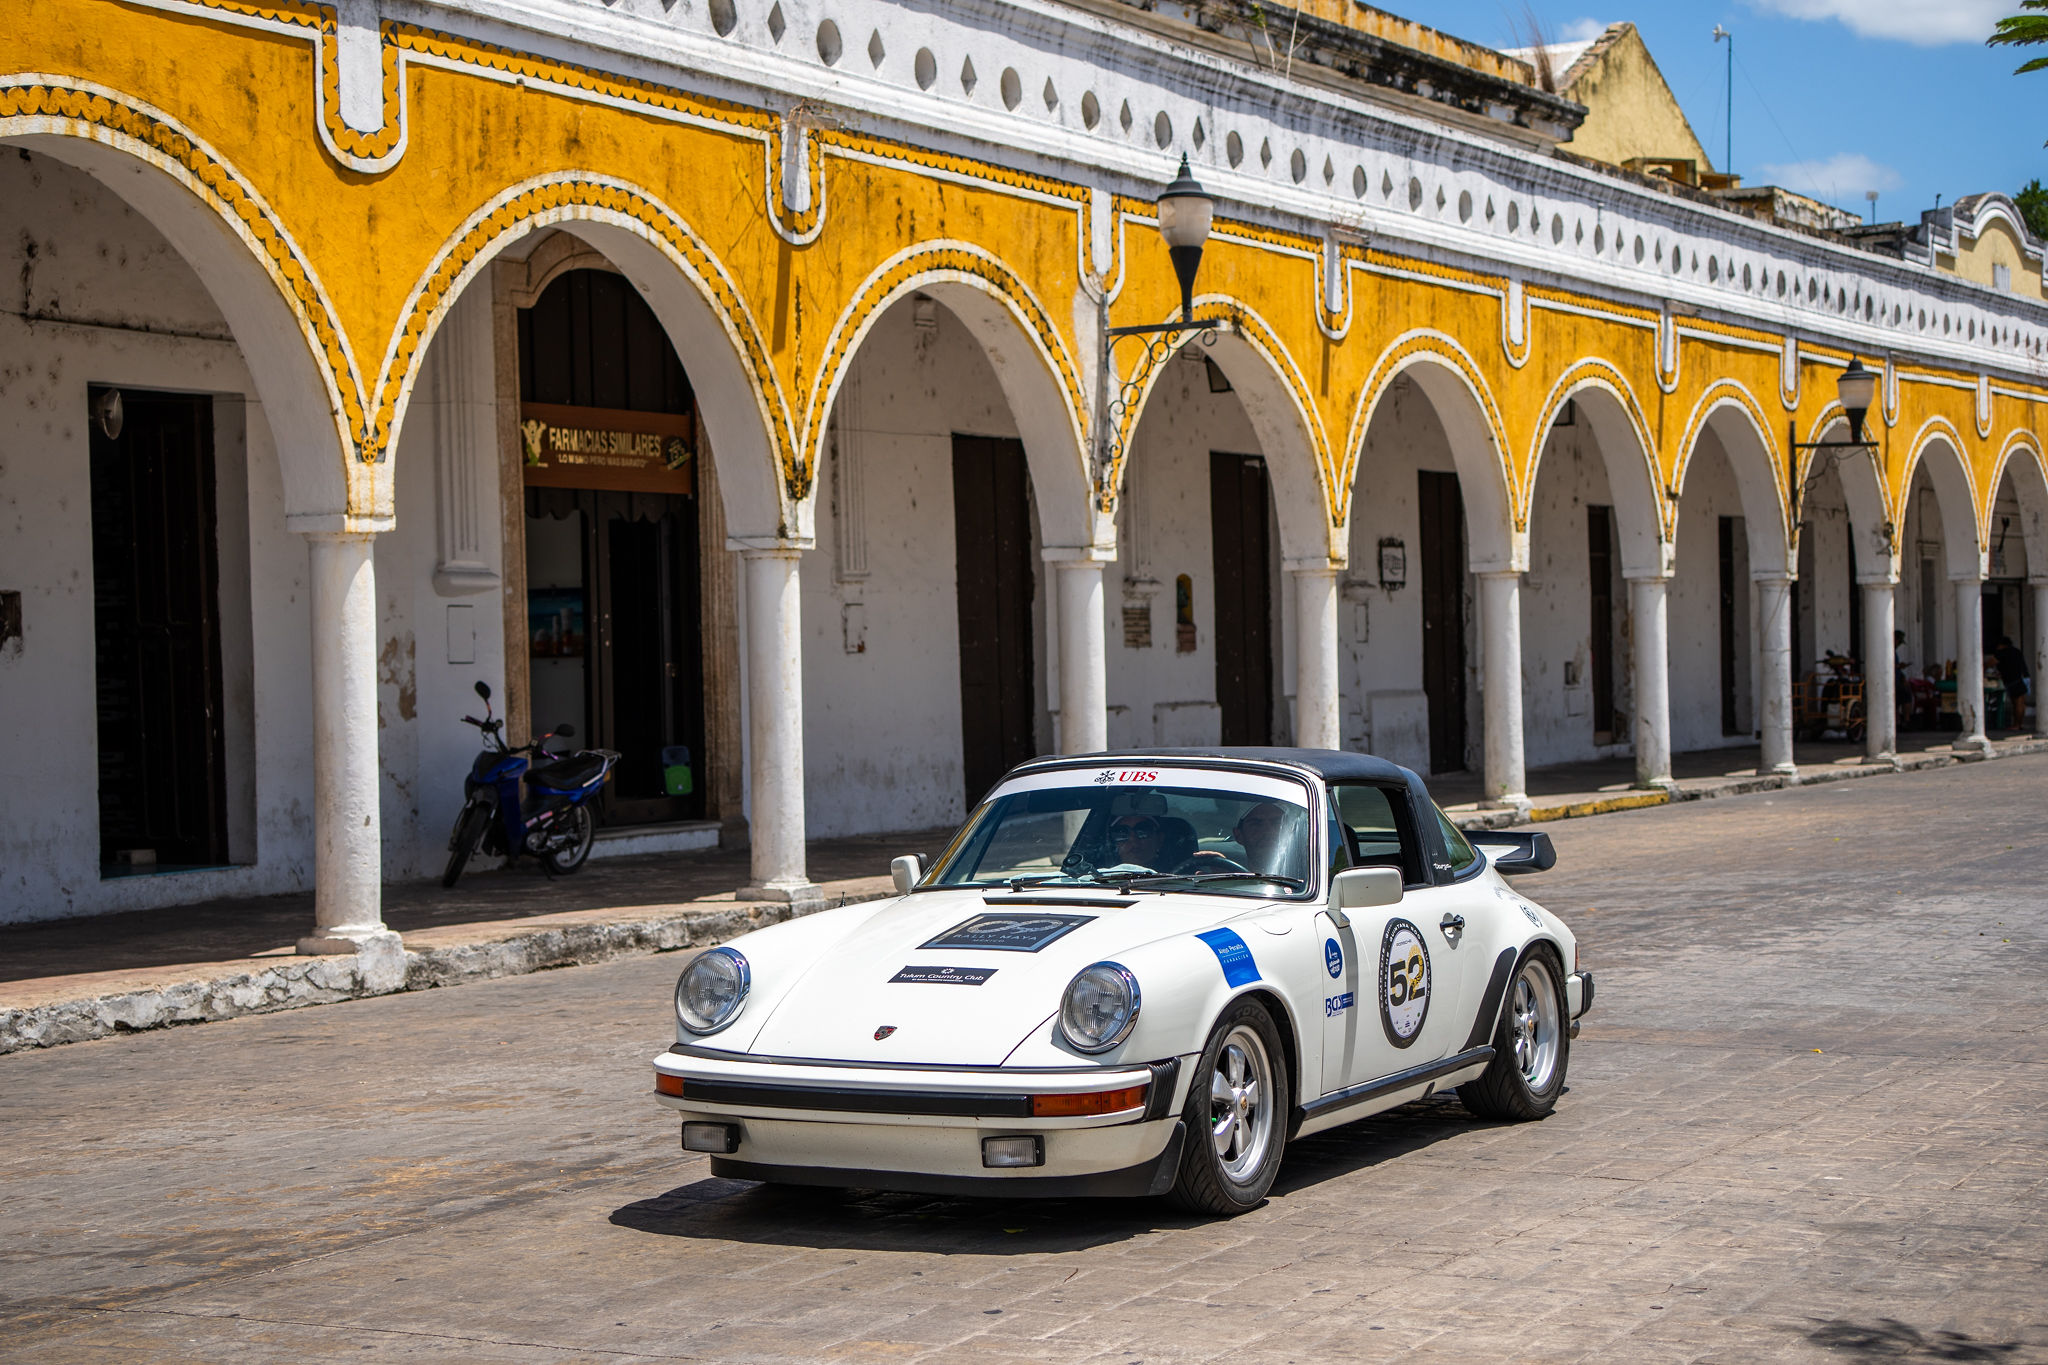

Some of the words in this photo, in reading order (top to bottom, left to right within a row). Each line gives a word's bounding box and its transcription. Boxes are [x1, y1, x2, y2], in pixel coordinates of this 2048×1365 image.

[549, 427, 608, 453] FARMACIAS
[609, 431, 661, 457] SIMILARES
[1119, 771, 1158, 782] UBS
[1390, 954, 1425, 1006] 52
